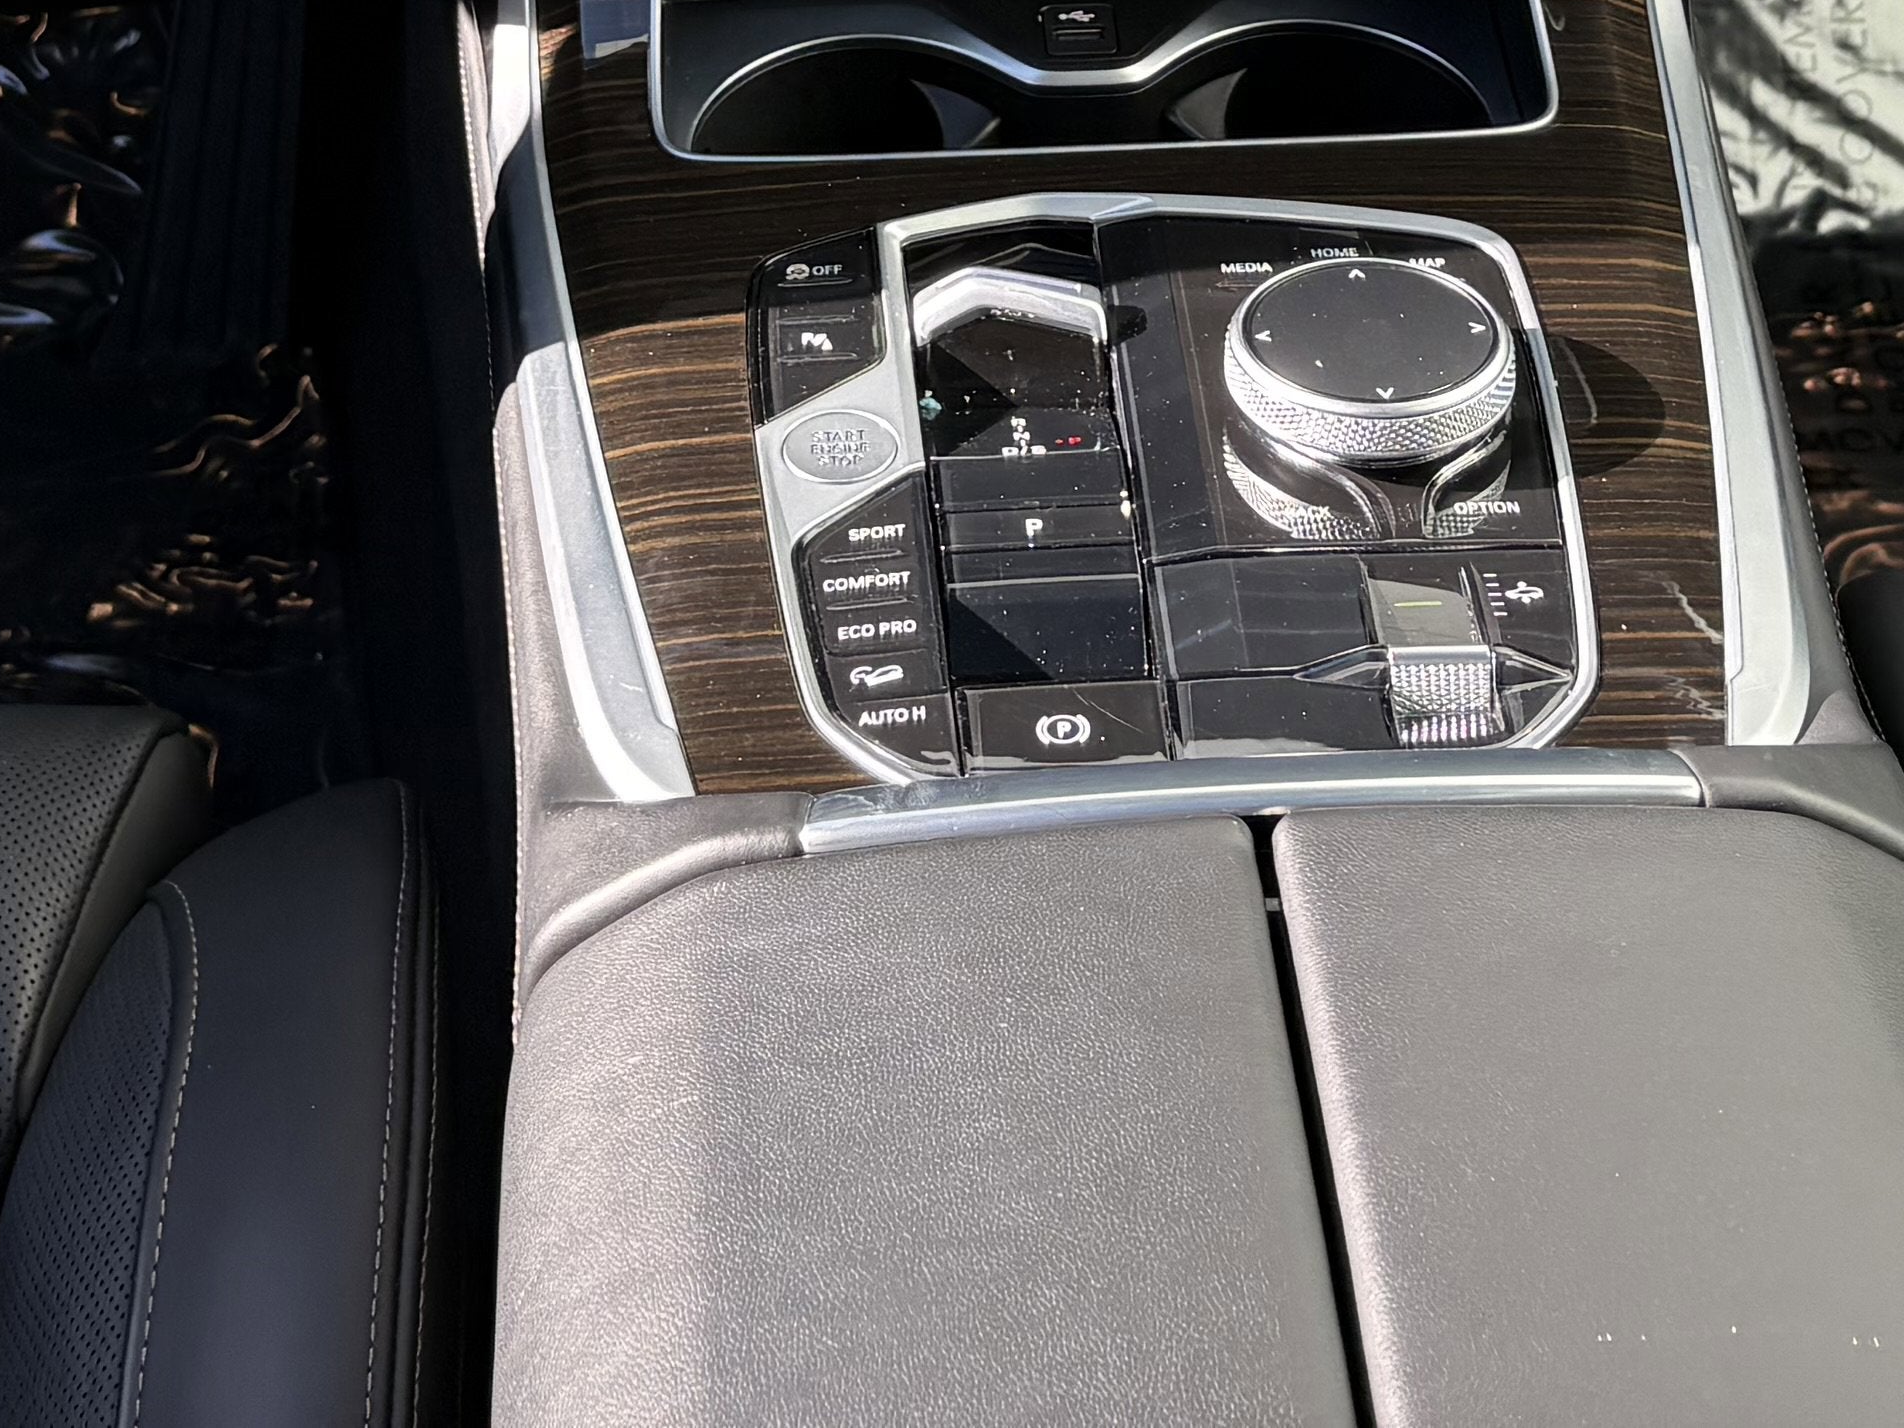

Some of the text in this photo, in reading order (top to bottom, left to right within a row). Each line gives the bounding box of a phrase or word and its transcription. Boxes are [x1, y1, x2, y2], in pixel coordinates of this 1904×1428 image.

[1310, 247, 1359, 258] HOME
[1220, 262, 1274, 274] MEDIA
[1409, 257, 1446, 269] MAP
[811, 264, 844, 277] OFF
[811, 429, 866, 443] START
[810, 442, 870, 455] ENGINE
[817, 454, 863, 466] STOP
[1453, 501, 1520, 515] OPTION
[848, 524, 906, 542] SPORT
[1025, 518, 1043, 537] P
[823, 571, 911, 592] COMFORT
[837, 619, 917, 640] ECO PRO
[859, 705, 926, 727] AUTO H
